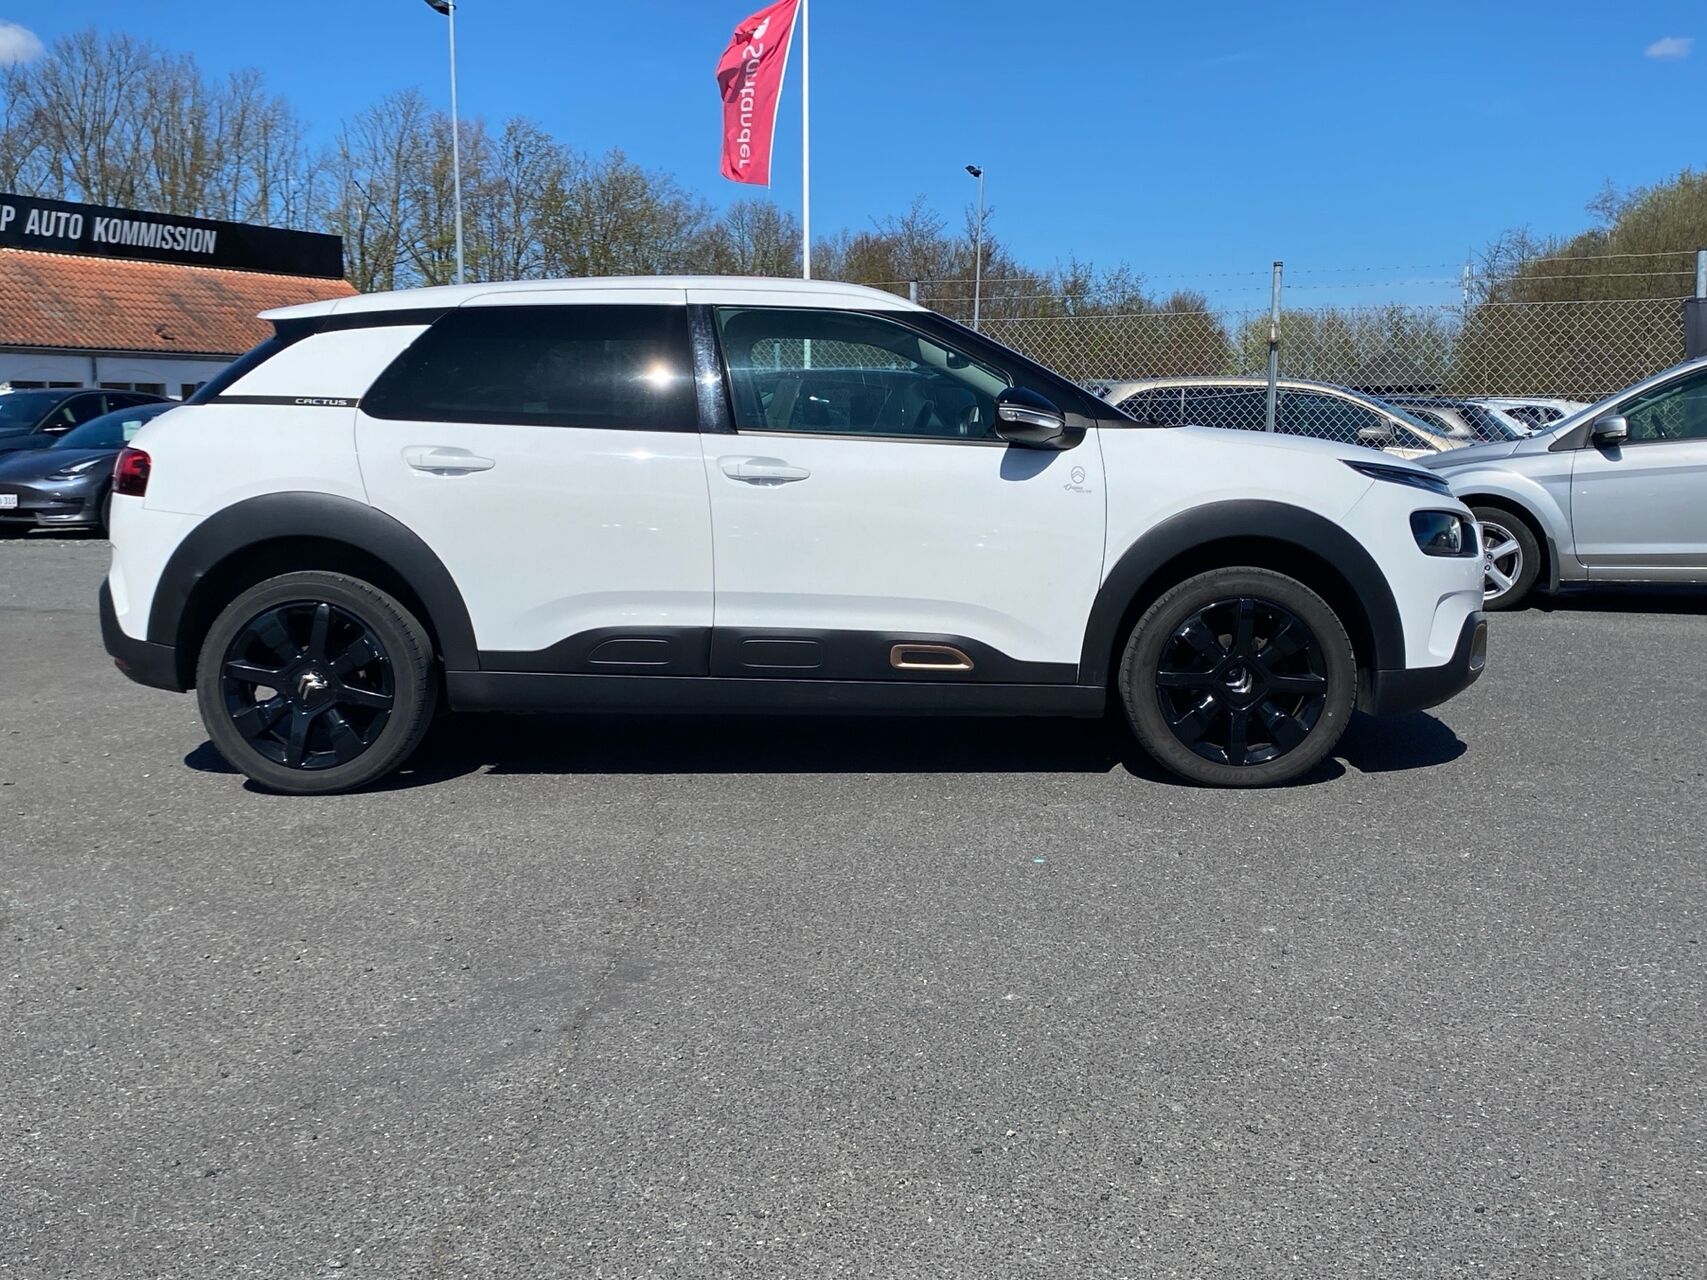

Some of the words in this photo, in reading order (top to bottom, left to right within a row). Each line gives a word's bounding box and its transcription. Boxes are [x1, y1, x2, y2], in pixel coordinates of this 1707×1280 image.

[0, 205, 15, 231] P
[25, 209, 82, 239] AUTO
[93, 217, 217, 254] KOMMISSION
[295, 398, 347, 406] CACTUS
